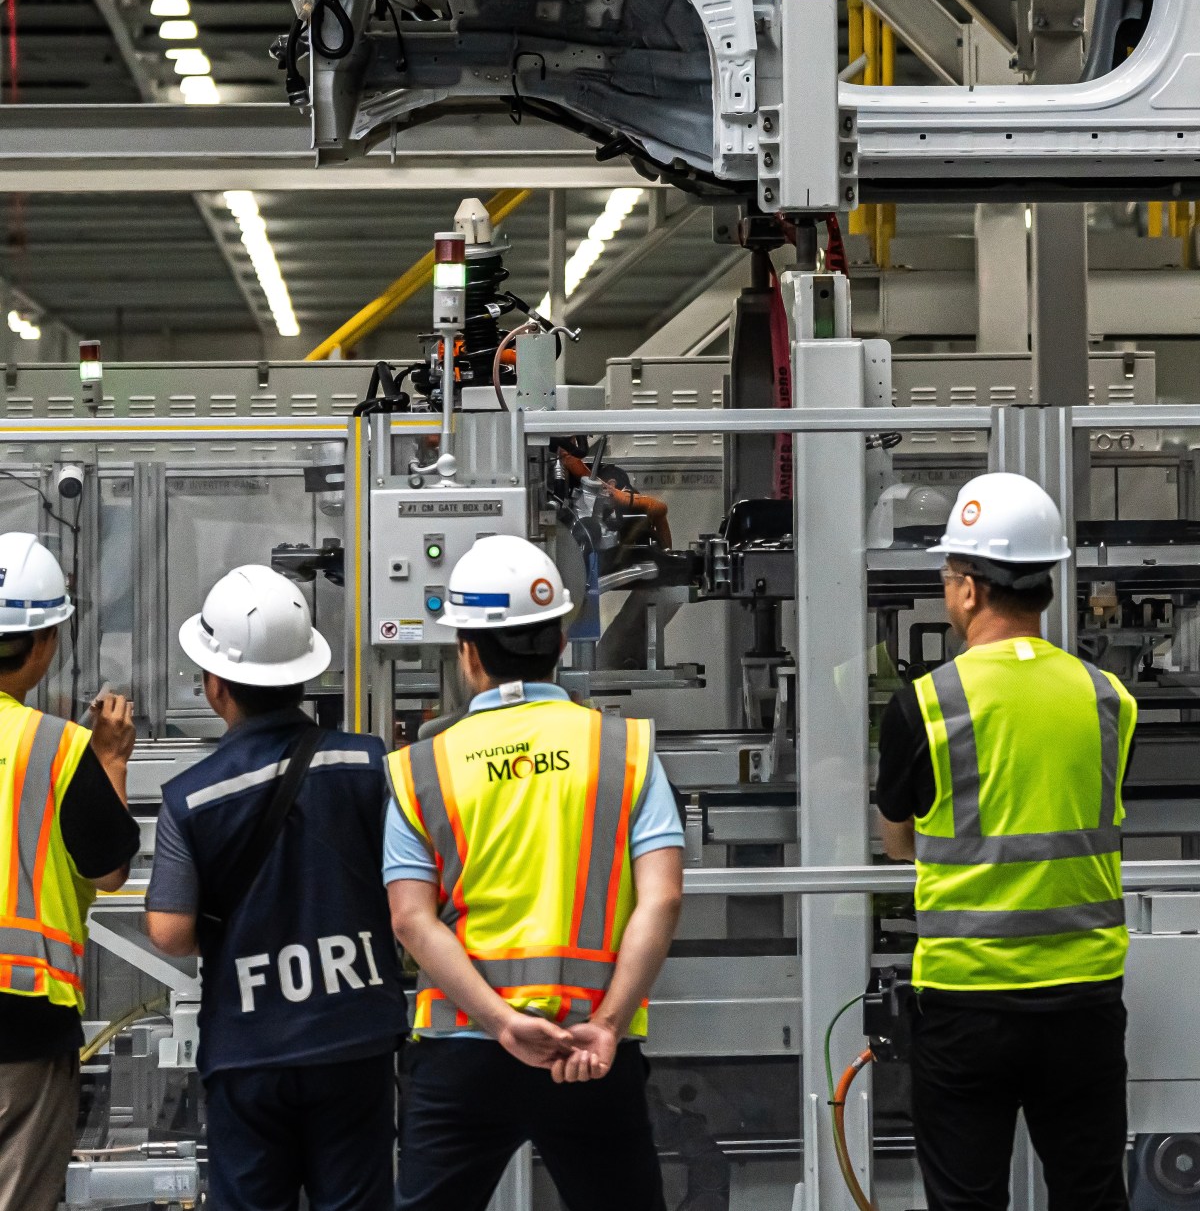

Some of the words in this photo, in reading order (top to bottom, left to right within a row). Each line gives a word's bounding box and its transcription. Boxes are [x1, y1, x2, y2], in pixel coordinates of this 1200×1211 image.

[407, 504, 417, 512] #1
[421, 504, 434, 512] CM
[438, 504, 458, 512] GATE
[462, 503, 479, 512] BOX
[483, 503, 493, 511] 04
[465, 742, 530, 762] HYUNDAI
[486, 750, 570, 781] MOBIS
[235, 931, 384, 1013] FORI
